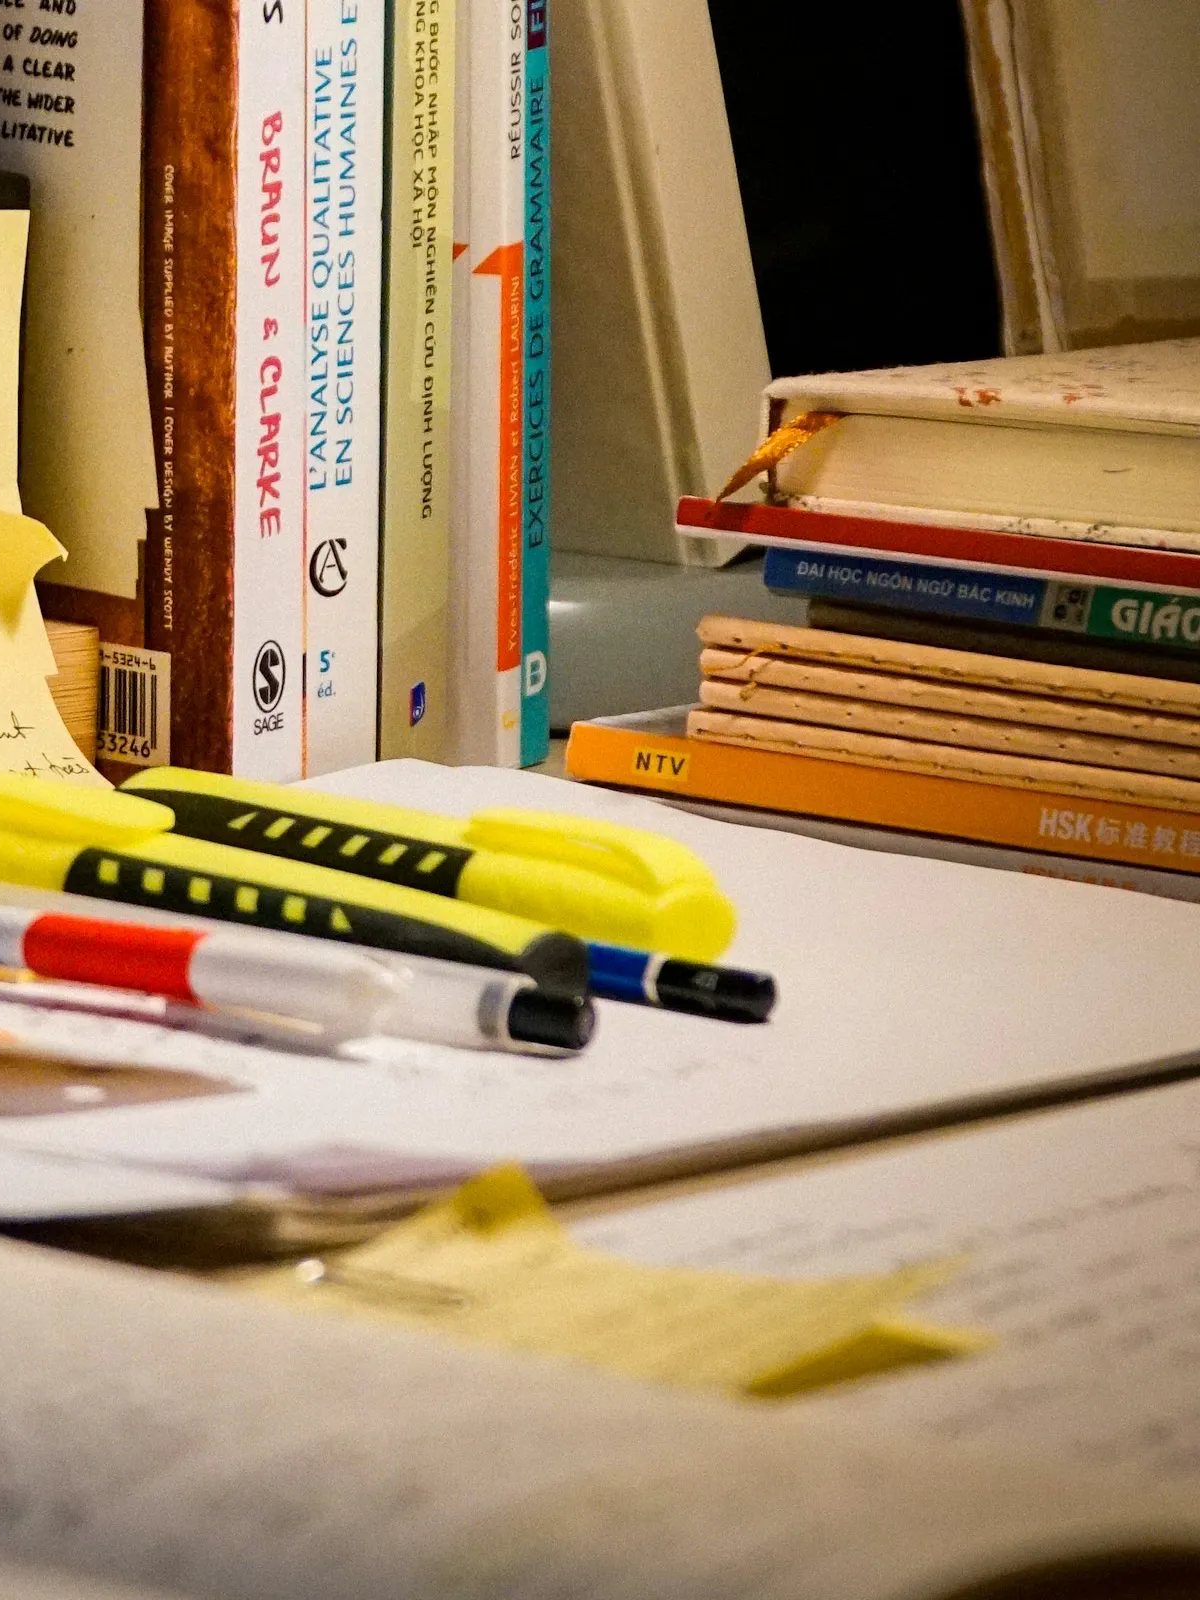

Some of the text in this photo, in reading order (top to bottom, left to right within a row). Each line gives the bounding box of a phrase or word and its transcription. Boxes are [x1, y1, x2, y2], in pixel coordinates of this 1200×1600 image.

[3, 24, 23, 41] OF
[29, 26, 78, 48] DOING
[428, 23, 440, 85] BƯỚC
[3, 54, 14, 72] A
[22, 57, 75, 81] CLEAR
[415, 41, 426, 106] KHOA
[508, 0, 522, 160] RÉUSSIR SO
[27, 92, 75, 114] WIDER
[338, 38, 357, 237] HUMAINES
[411, 114, 425, 160] HỌC
[163, 164, 175, 203] COVER
[259, 111, 283, 287] BRAUN
[412, 169, 423, 201] XÃ
[427, 167, 438, 219] MÔN
[162, 210, 175, 252] IMAGE
[410, 208, 423, 249] HỘI
[163, 258, 174, 317] SUPPLIED
[309, 46, 334, 490] L'ANALYSE QUALITATIVE
[425, 227, 438, 315] NGHIÊN
[163, 323, 174, 340] BY
[511, 276, 521, 352] LAURINI
[528, 77, 544, 549] EXERCICES DE GRAMMAIRE
[336, 250, 355, 424] SCIENCES
[163, 346, 174, 398] AUTHOR
[510, 361, 520, 424] Robert
[421, 377, 434, 434] ĐỊNH
[163, 416, 174, 454] COVER
[257, 355, 282, 538] CLARKE
[511, 429, 519, 447] et
[163, 461, 173, 507] DESIGN
[336, 439, 352, 486] EN
[420, 440, 433, 519] LƯỢNG
[509, 455, 519, 516] LIVIAN
[163, 514, 173, 531] BY
[163, 539, 173, 583] WENDY
[797, 561, 825, 580] ĐẠI
[827, 565, 863, 585] HỌC
[866, 570, 913, 592] NGÔN
[916, 577, 955, 598] NGỮ
[995, 590, 1035, 609] KINH
[163, 589, 173, 631] SCOTT
[317, 680, 336, 698] éd.
[253, 712, 285, 736] SAGE
[636, 752, 685, 775] NTV
